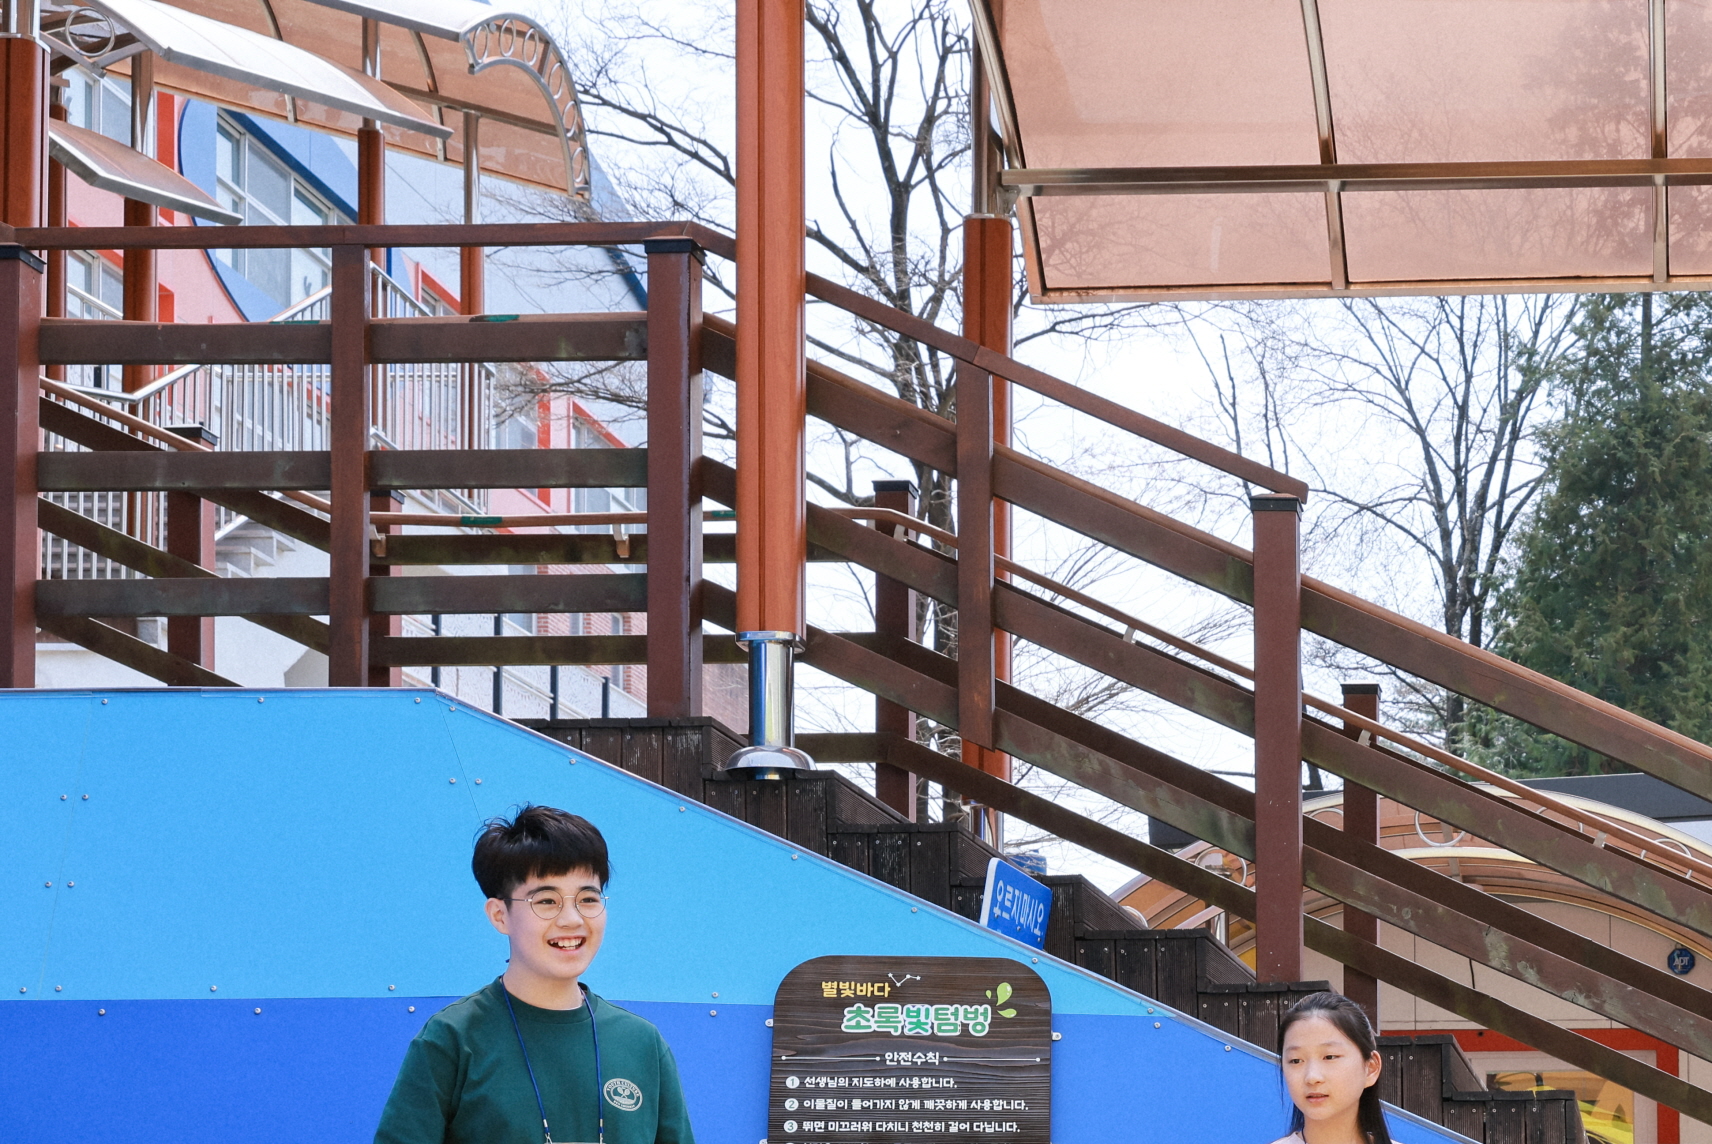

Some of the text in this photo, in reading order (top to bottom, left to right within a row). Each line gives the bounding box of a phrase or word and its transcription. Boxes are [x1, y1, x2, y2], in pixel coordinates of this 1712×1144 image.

[1673, 956, 1689, 966] ADT
[821, 981, 891, 998] 별빛바다
[841, 1002, 992, 1037] 초록빛텀벙
[884, 1051, 940, 1066] 안전수칙
[804, 1076, 848, 1088] 선생님의
[852, 1076, 896, 1088] 지도하에
[899, 1076, 958, 1088] 사용합니다.
[804, 1099, 848, 1110] 이물질이
[852, 1099, 895, 1110] 들어가지
[898, 1099, 920, 1110] 않게
[924, 1099, 967, 1110] 깨끗하게
[970, 1099, 1029, 1110] 사용합니다.
[802, 1121, 824, 1132] 뛰면
[828, 1121, 872, 1132] 미끄러워
[876, 1121, 908, 1132] 다치니
[912, 1121, 944, 1132] 천천히
[948, 1121, 970, 1132] 걸어
[973, 1121, 1020, 1132] 다닙니다.
